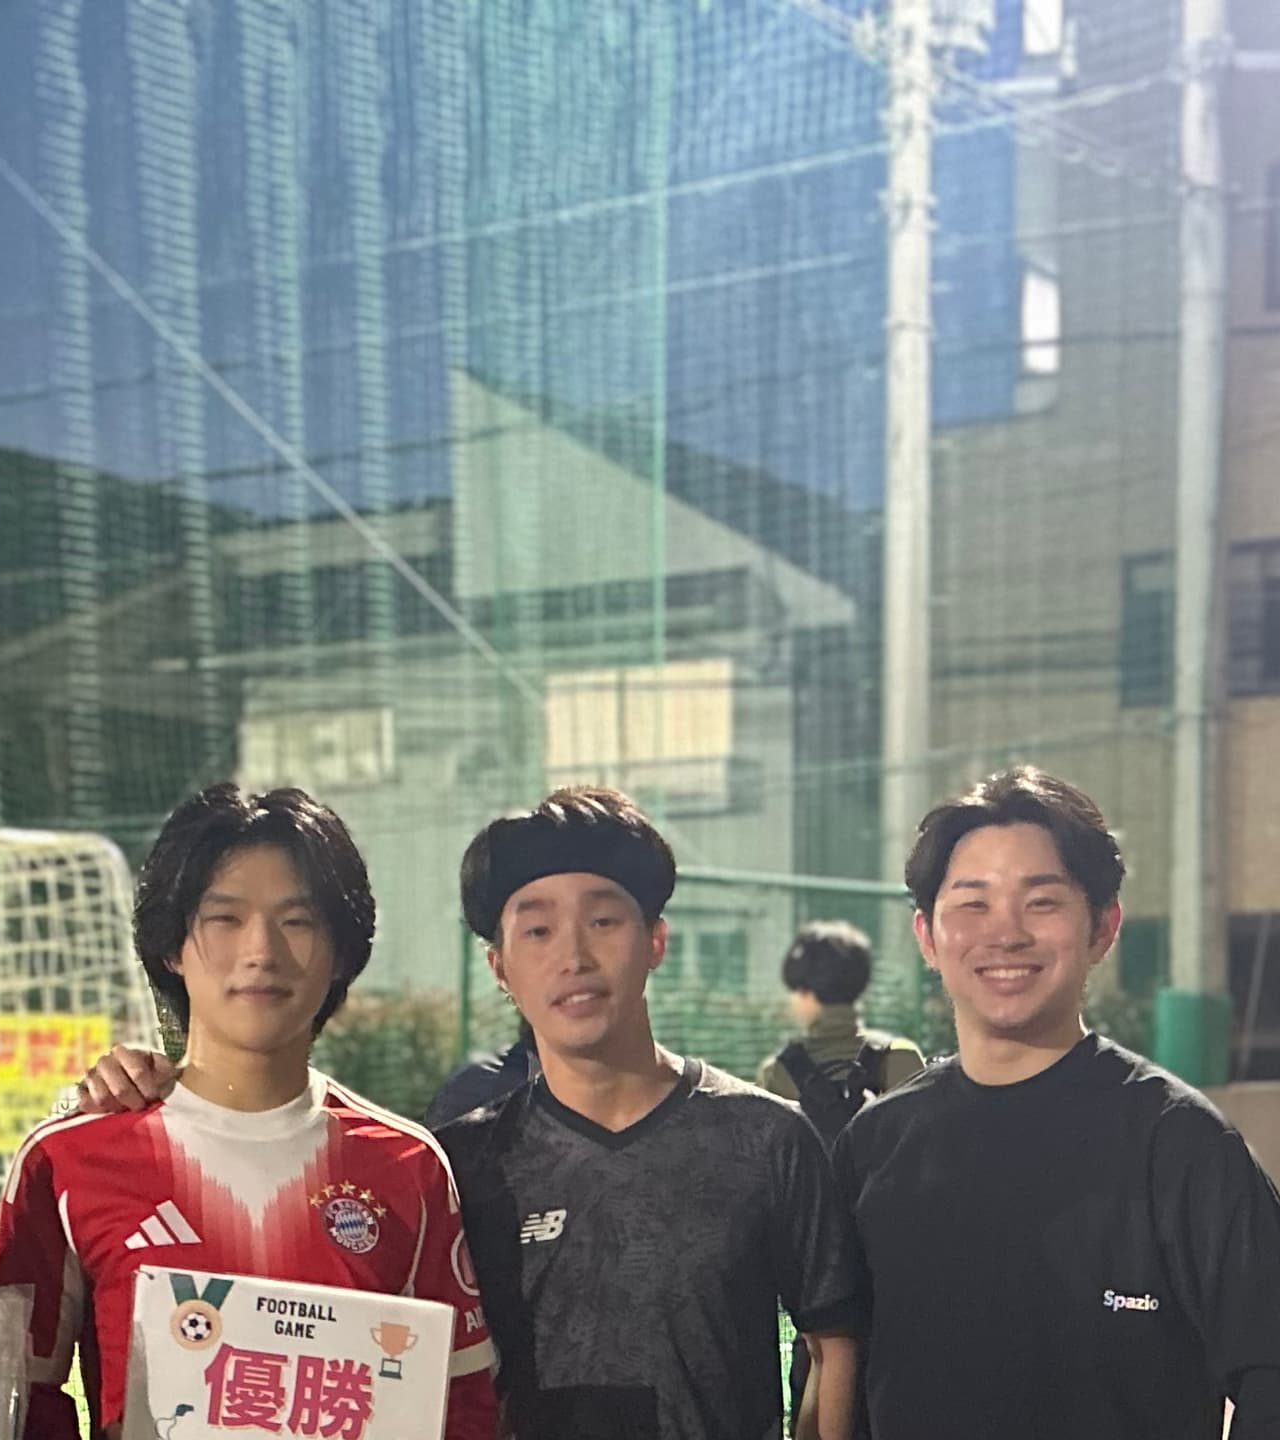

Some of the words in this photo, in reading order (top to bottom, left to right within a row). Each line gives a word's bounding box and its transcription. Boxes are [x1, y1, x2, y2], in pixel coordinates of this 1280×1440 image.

[256, 1296, 337, 1322] FOOTBALL
[1103, 1289, 1159, 1312] Spazio
[274, 1320, 316, 1339] GAME
[204, 1342, 373, 1440] 優勝
